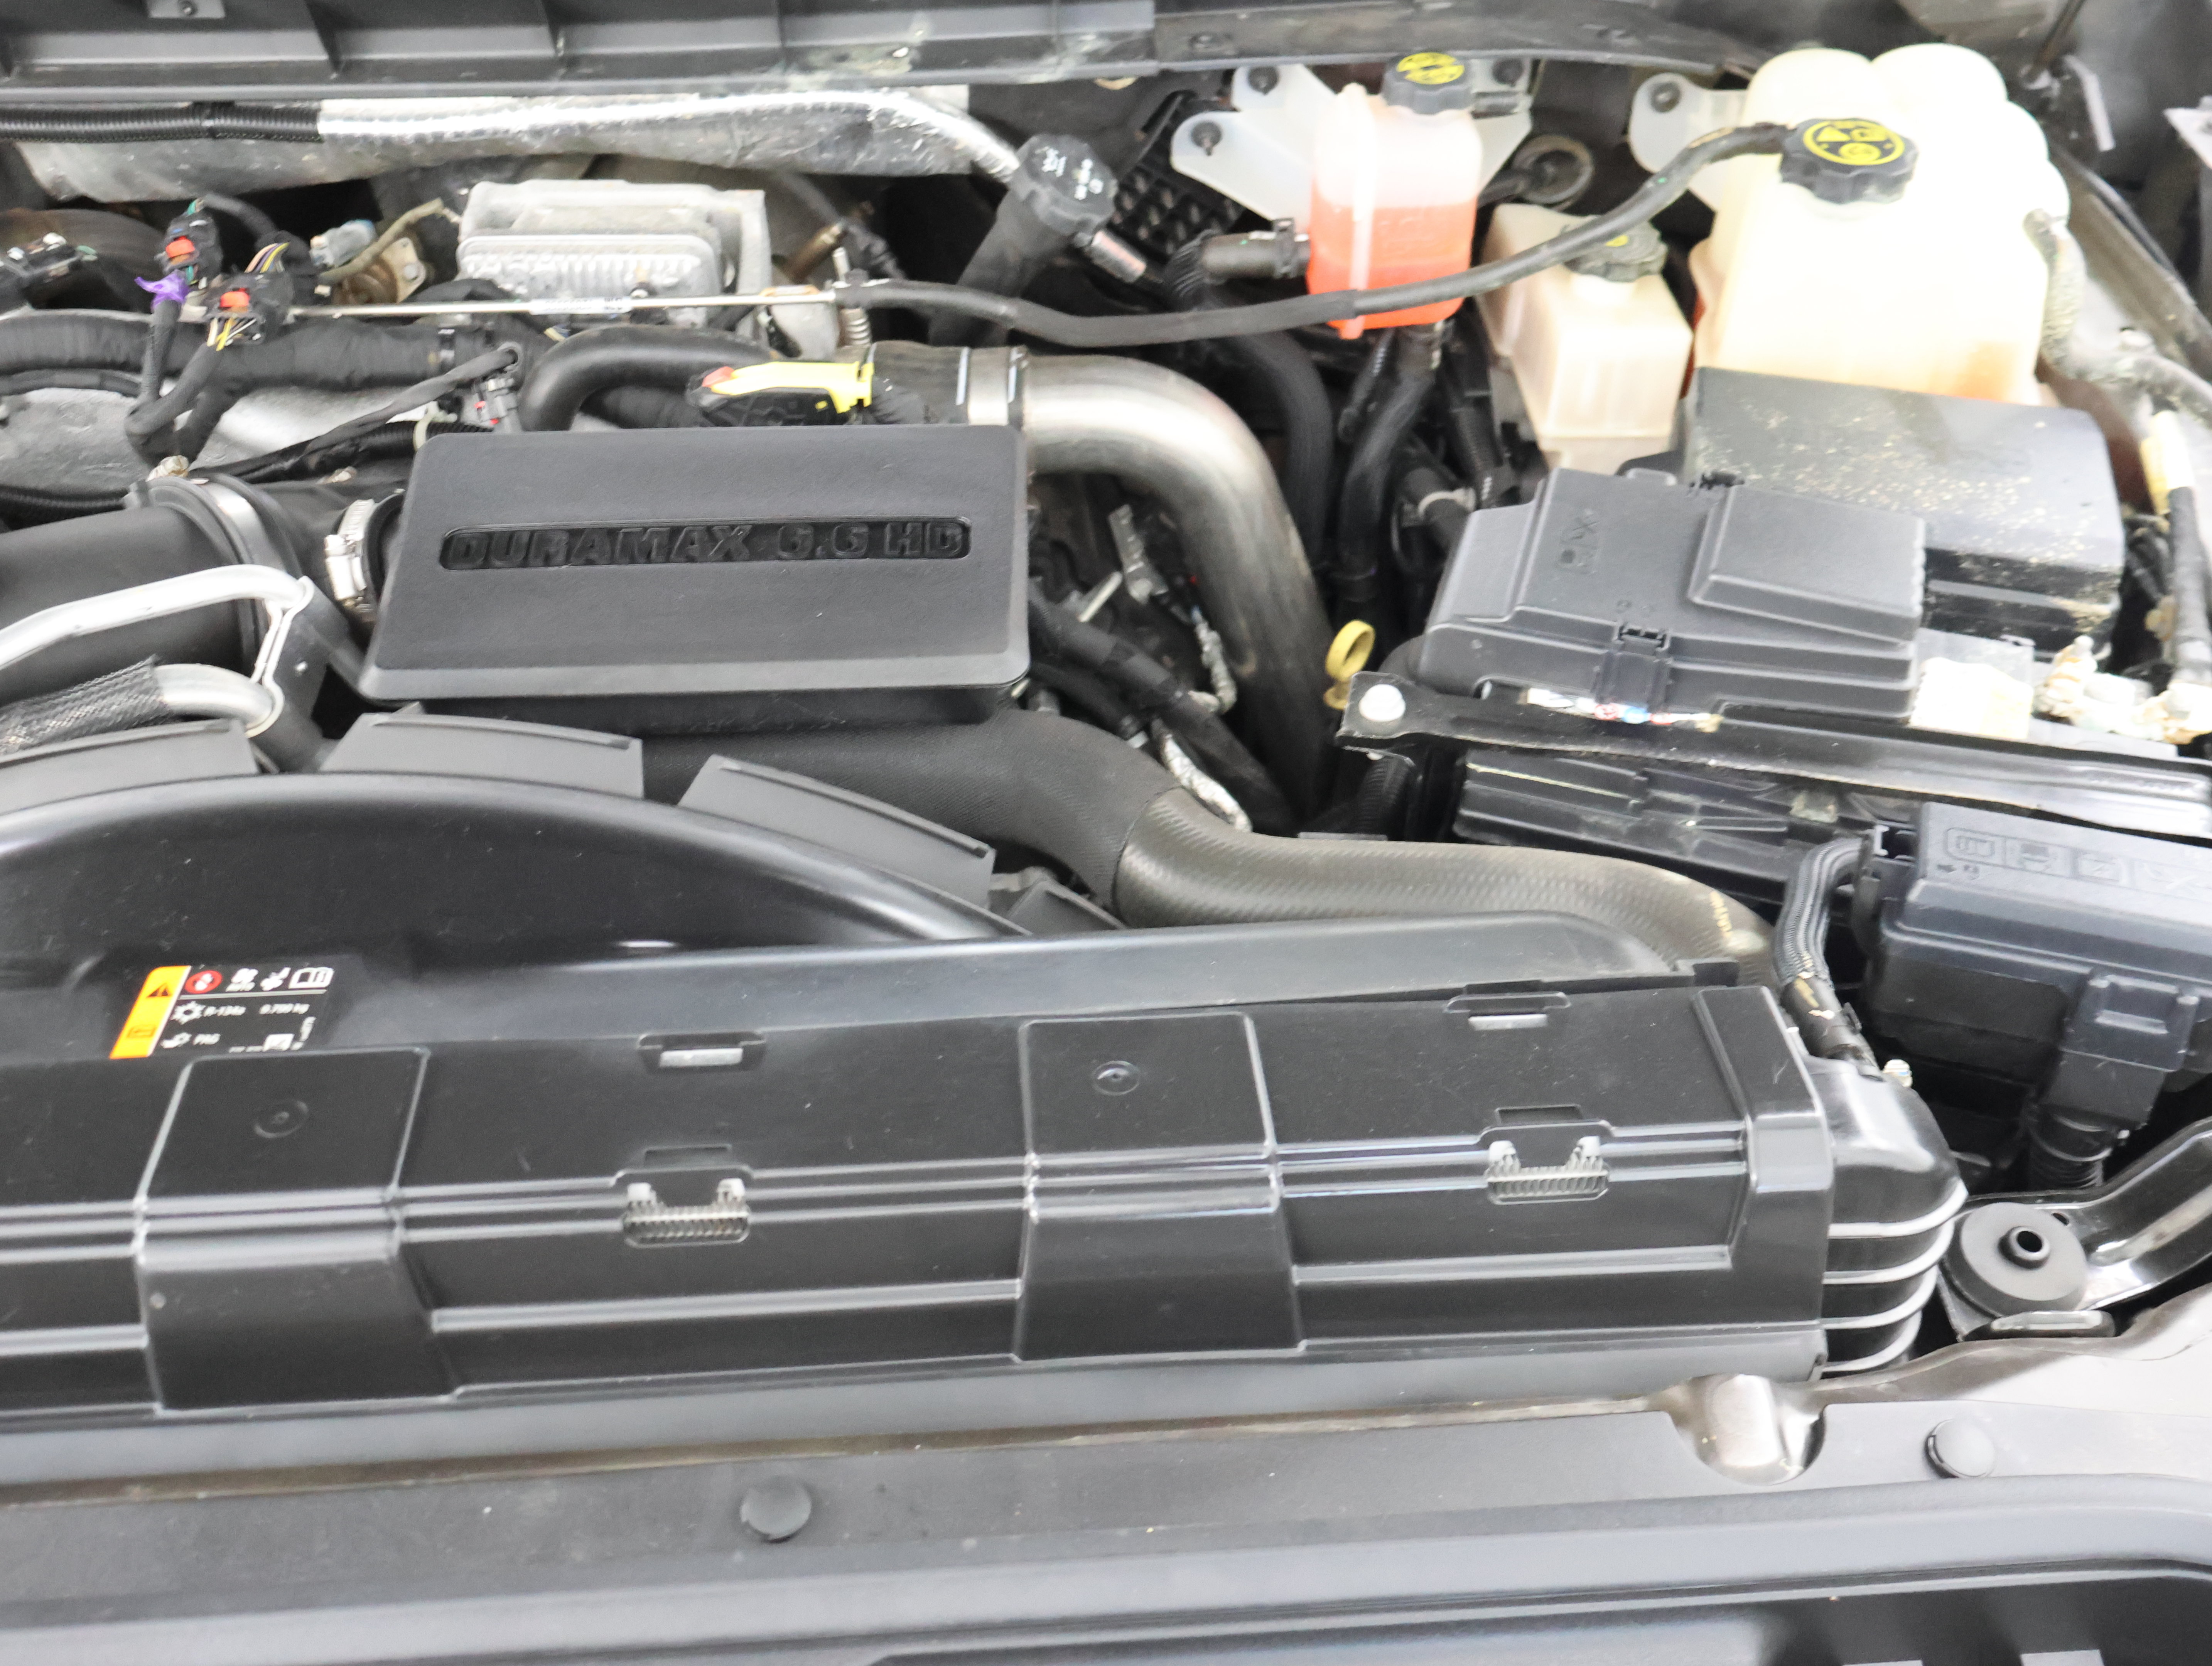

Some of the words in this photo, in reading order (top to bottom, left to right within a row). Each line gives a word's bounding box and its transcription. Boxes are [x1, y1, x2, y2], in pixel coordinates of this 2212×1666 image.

[449, 525, 752, 567] DURAMAX
[777, 522, 869, 559] 6.6
[885, 522, 962, 558] HD
